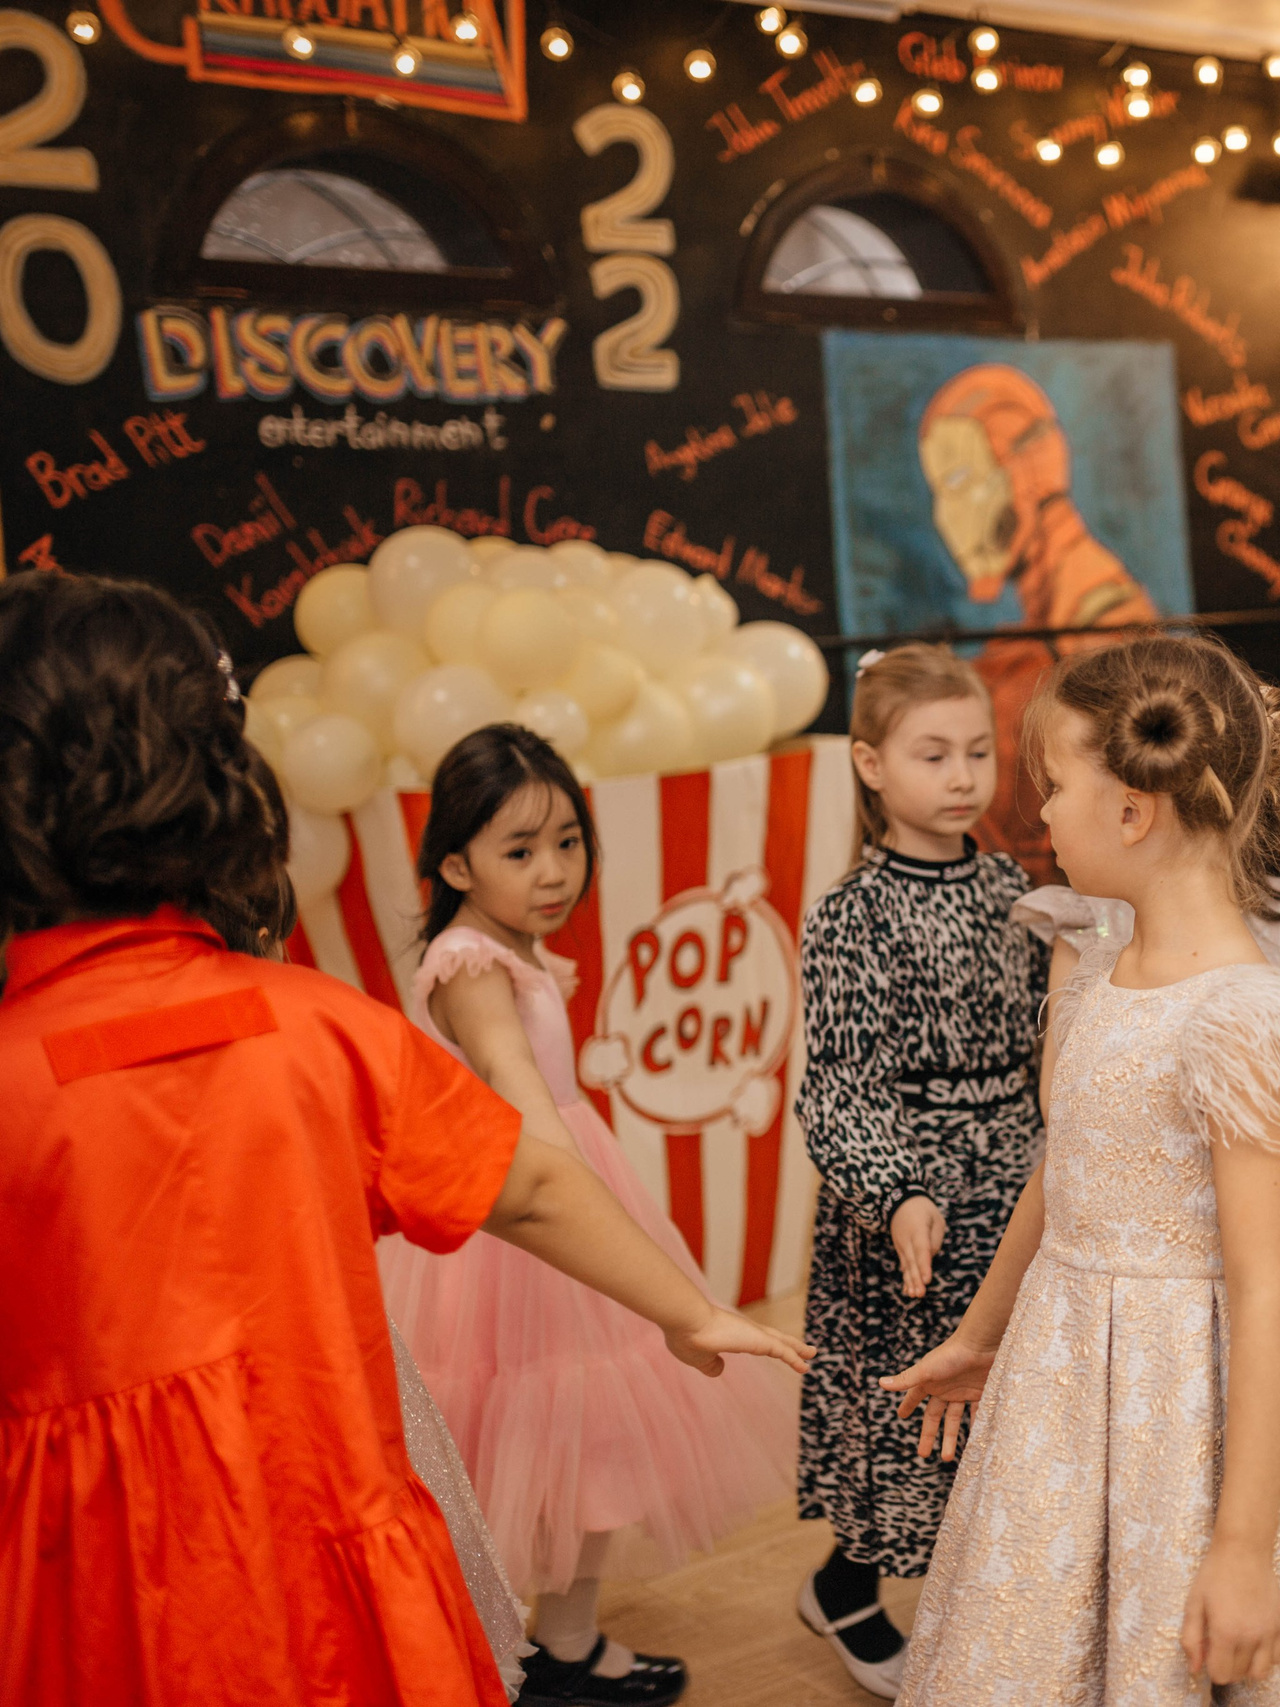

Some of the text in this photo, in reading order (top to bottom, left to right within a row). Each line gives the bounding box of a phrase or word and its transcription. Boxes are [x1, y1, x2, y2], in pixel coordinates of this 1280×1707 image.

[137, 303, 567, 402] DISCOVERY
[25, 410, 207, 509] Brad Pitt
[628, 906, 748, 1009] POP
[641, 998, 769, 1074] CORN
